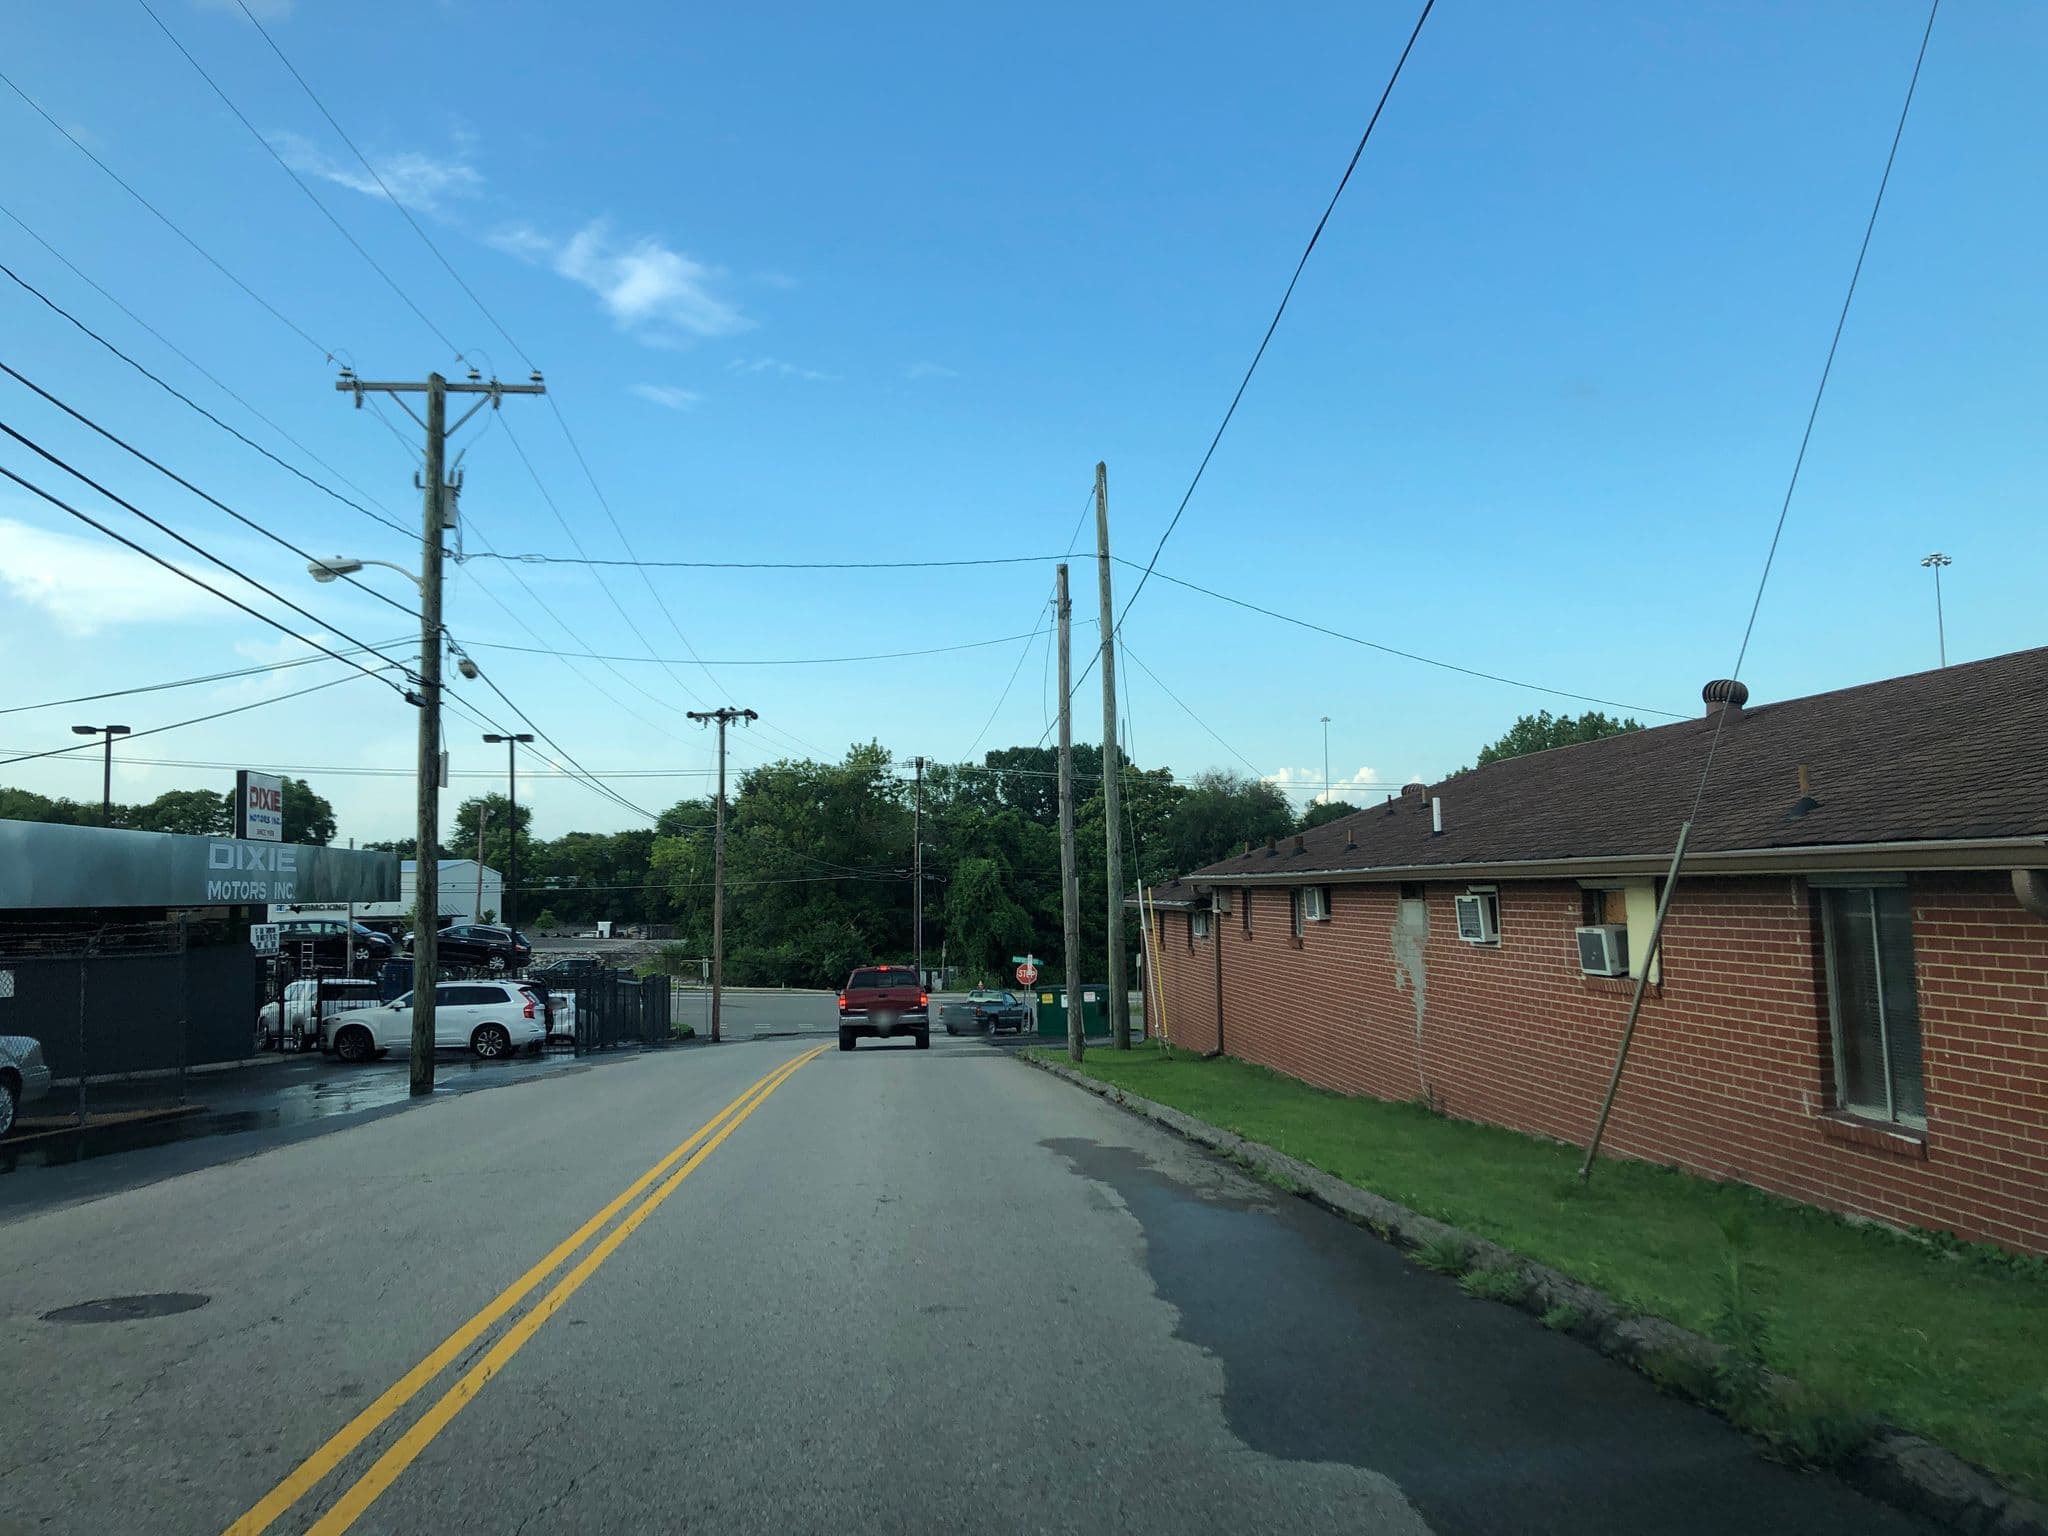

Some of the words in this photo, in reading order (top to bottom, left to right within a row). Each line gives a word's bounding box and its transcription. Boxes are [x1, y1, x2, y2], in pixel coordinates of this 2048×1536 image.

[249, 786, 281, 812] DIXIE
[208, 843, 297, 871] DIXIE
[207, 880, 267, 901] MOTORS
[327, 903, 347, 911] KING
